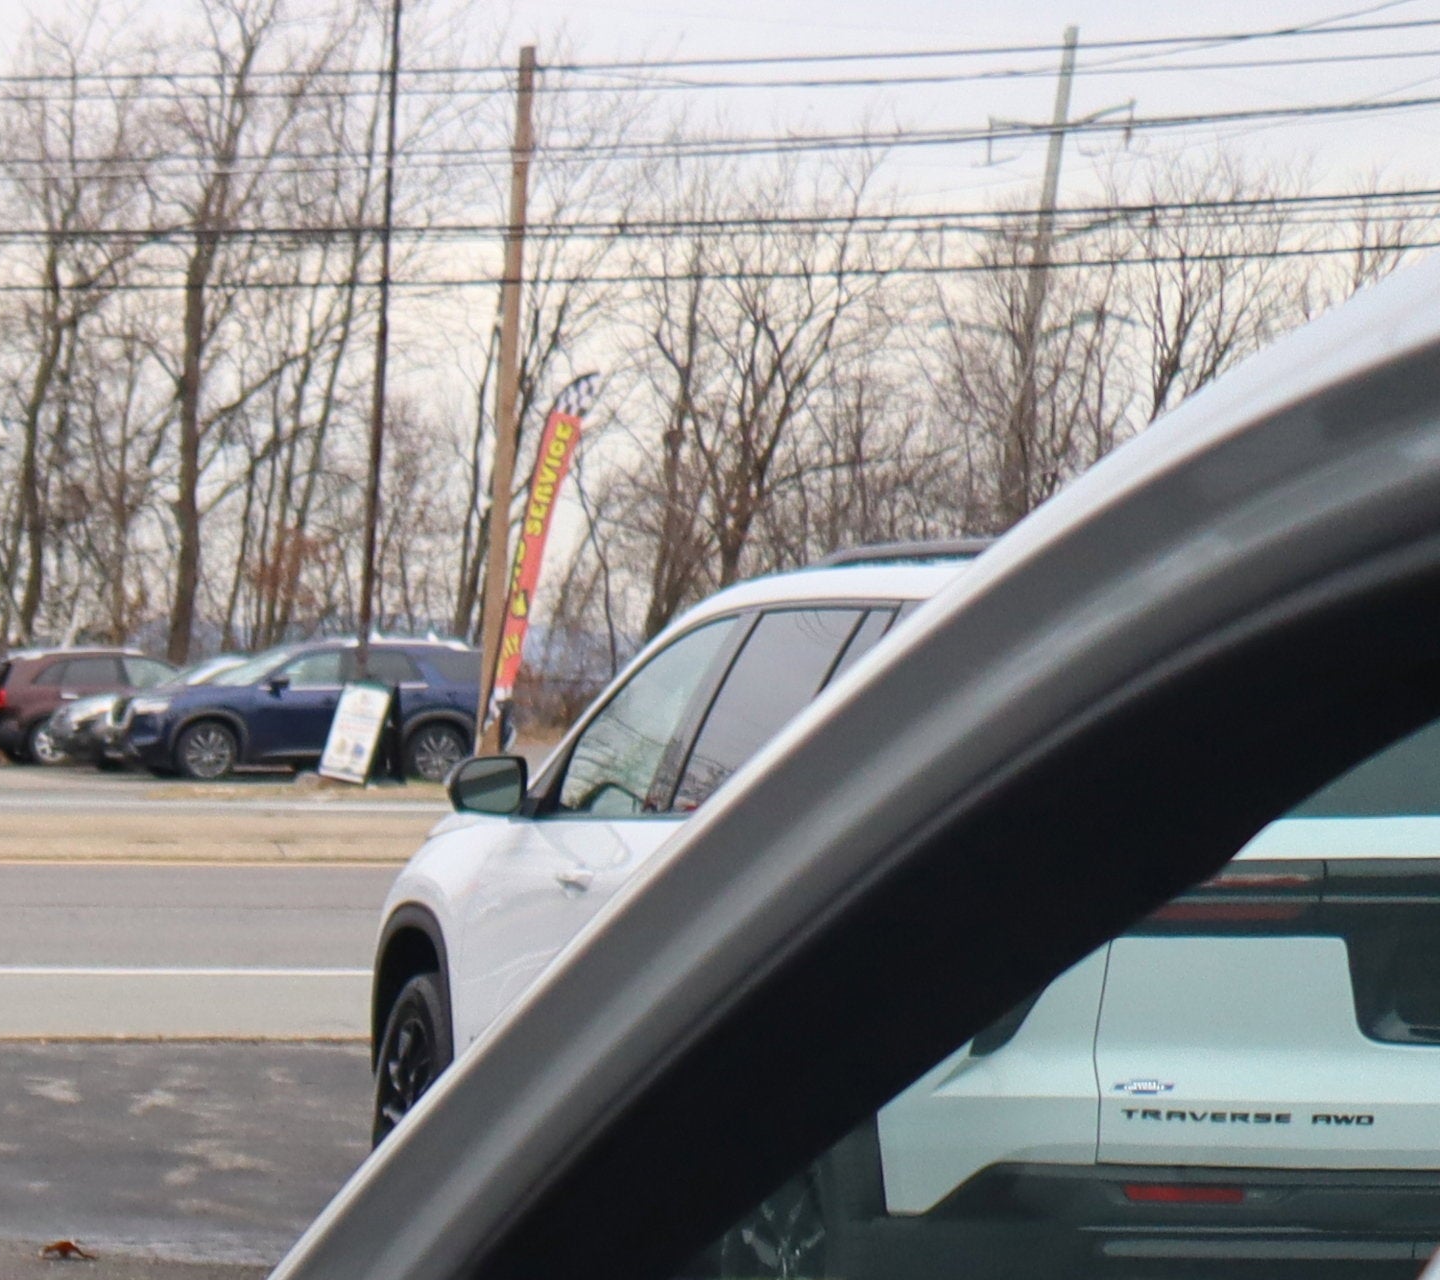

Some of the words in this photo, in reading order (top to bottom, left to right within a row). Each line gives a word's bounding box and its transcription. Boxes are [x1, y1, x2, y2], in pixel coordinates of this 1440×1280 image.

[525, 420, 574, 536] SERVICE
[1121, 1108, 1292, 1124] TRAVERSE
[1312, 1112, 1375, 1126] AWD
